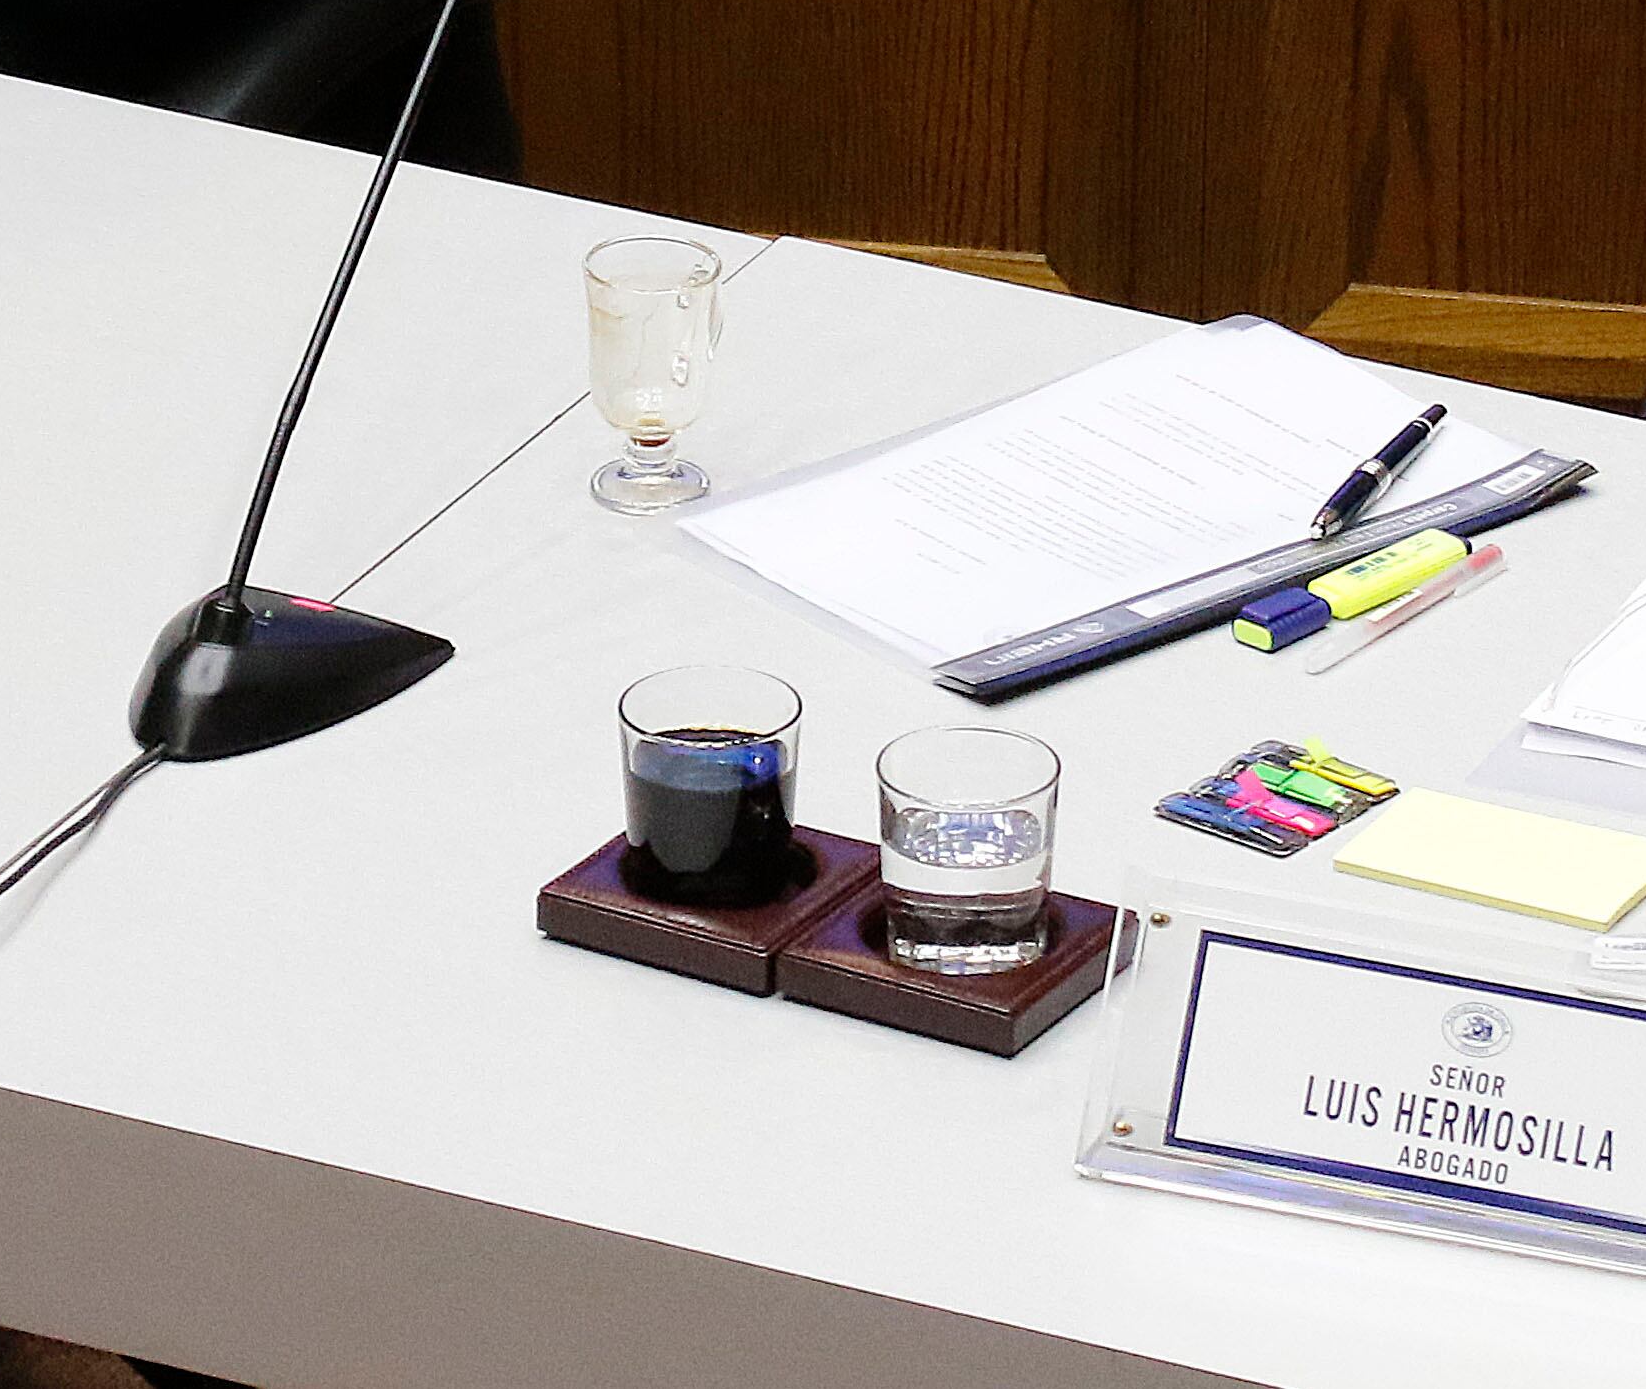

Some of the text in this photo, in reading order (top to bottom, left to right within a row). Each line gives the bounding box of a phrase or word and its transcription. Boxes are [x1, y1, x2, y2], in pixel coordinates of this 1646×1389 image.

[1429, 1063, 1506, 1099] SEÑOR
[1303, 1074, 1614, 1172] LUIS HERMOSILLA
[1397, 1145, 1509, 1185] ABOGADO
